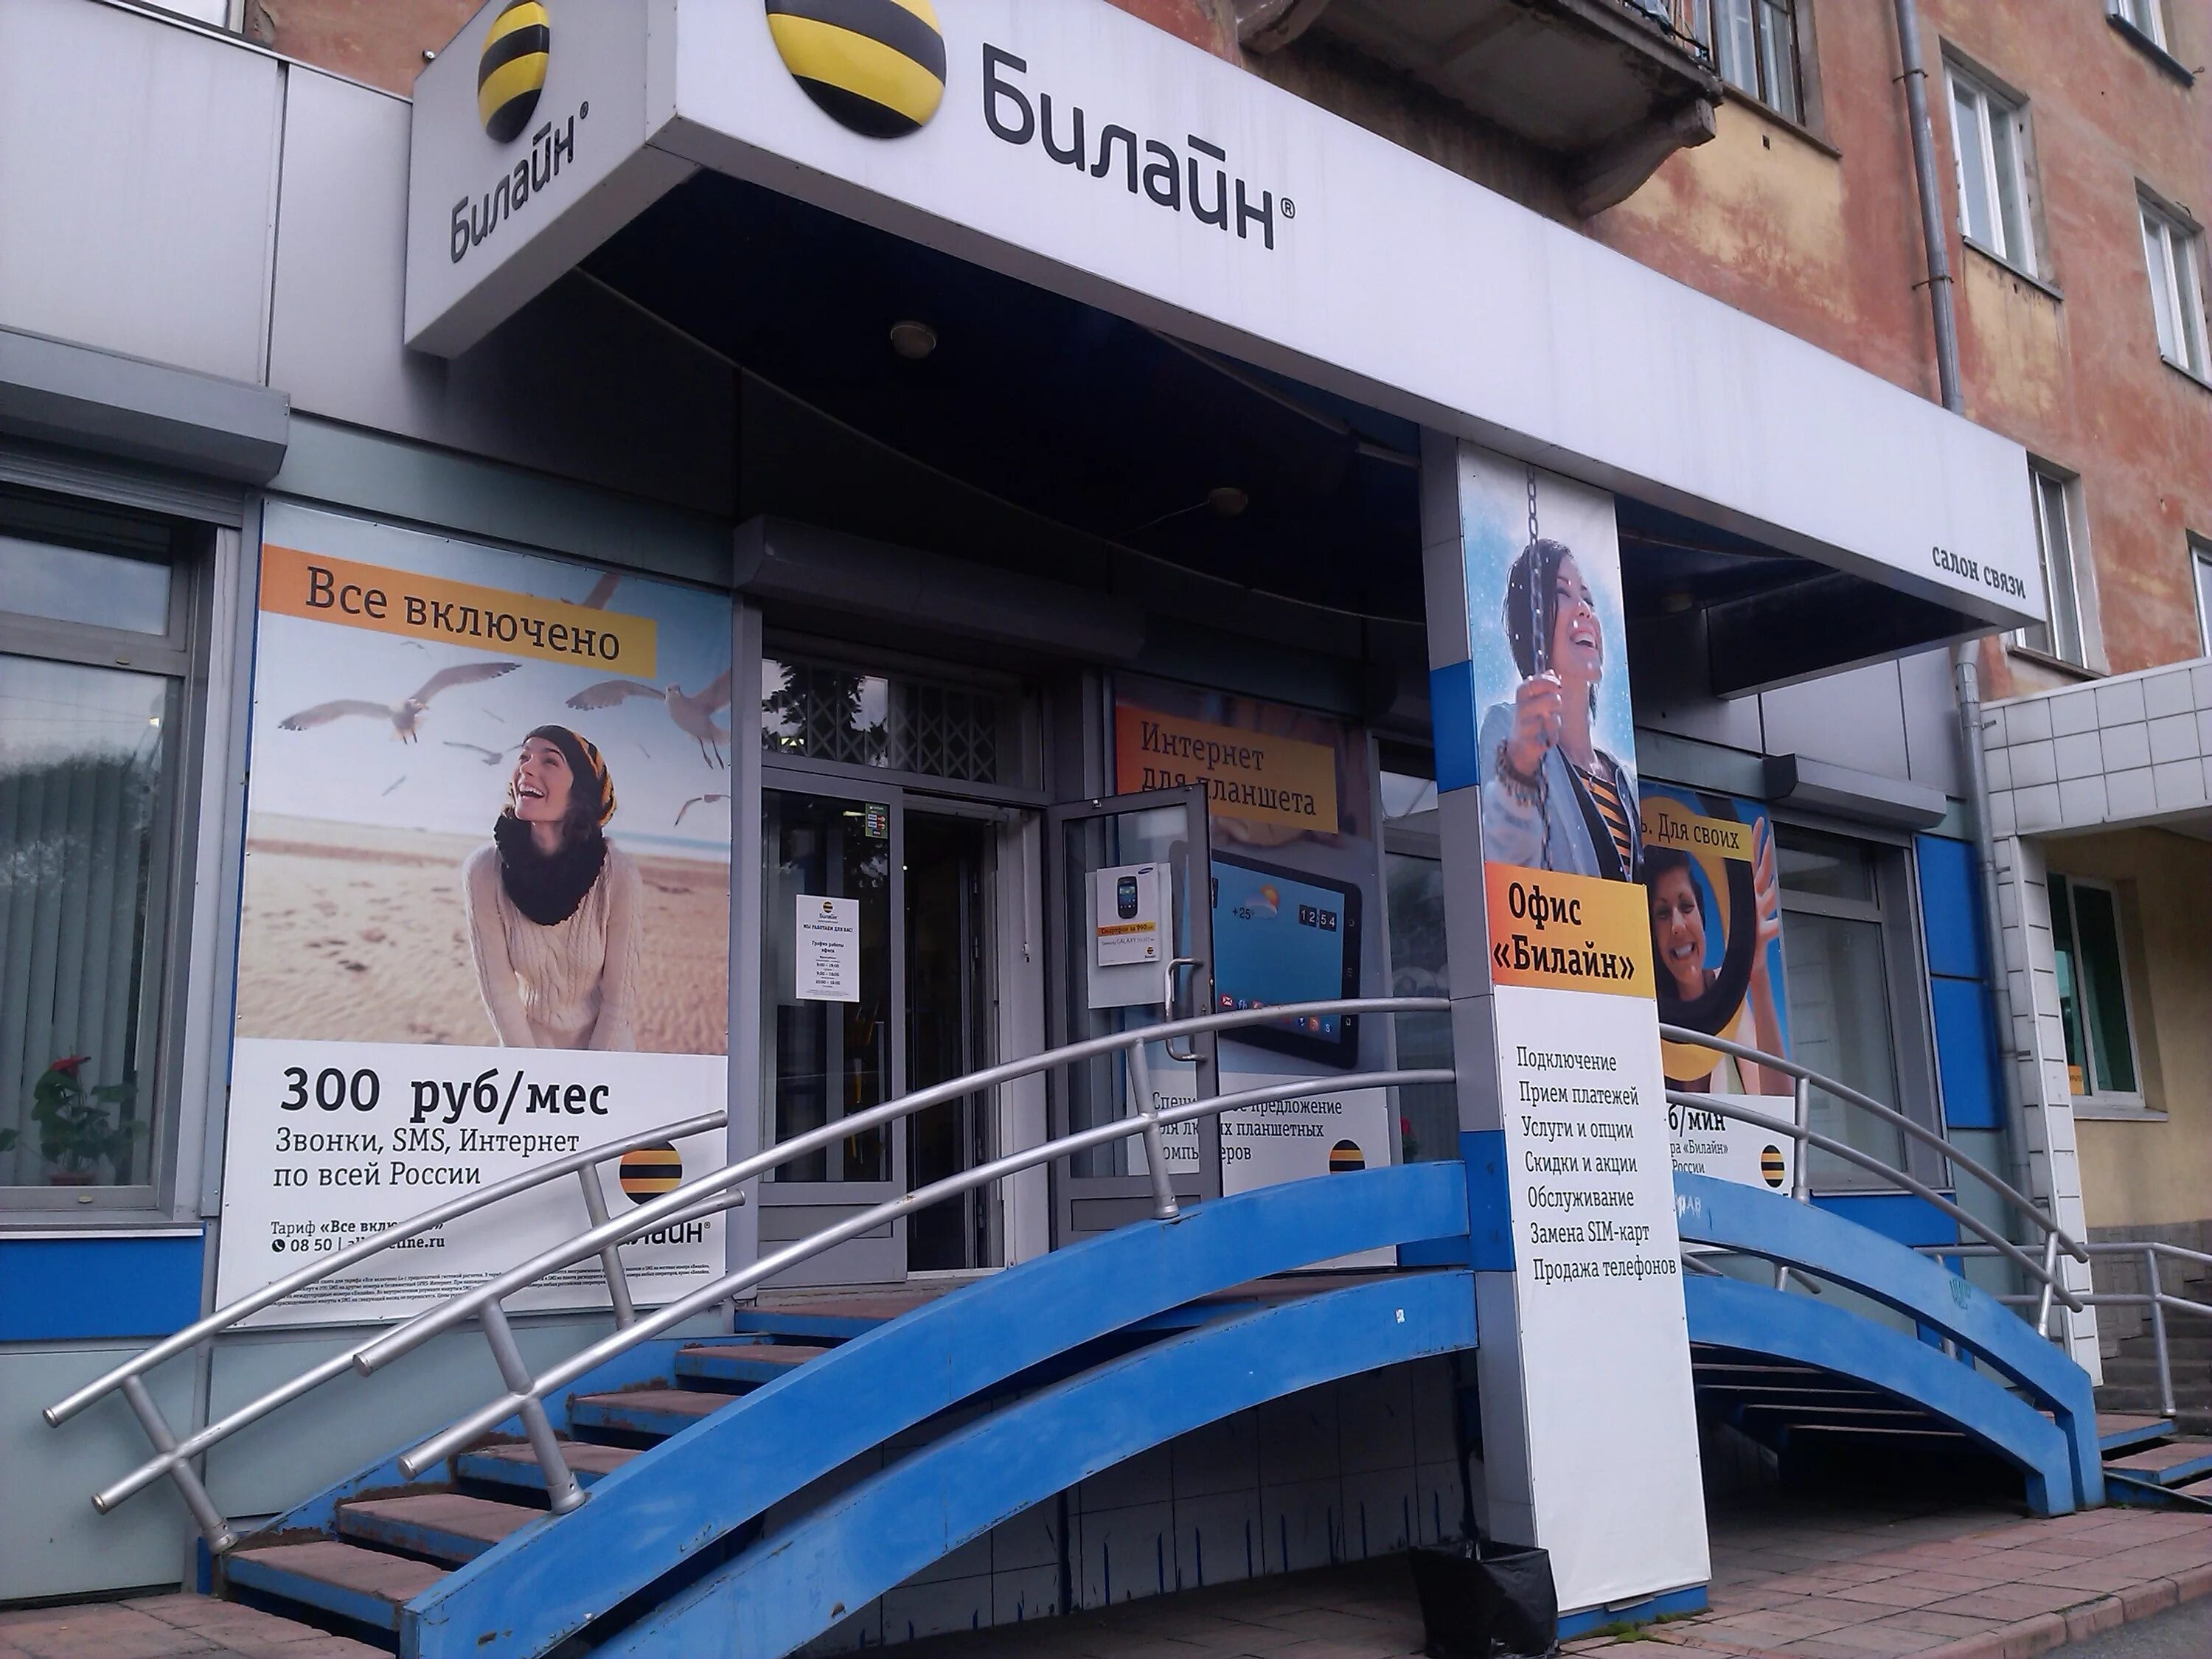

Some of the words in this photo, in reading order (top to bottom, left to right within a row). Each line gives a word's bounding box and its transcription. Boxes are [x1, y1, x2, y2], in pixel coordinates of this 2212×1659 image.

[1932, 546, 1980, 582] салон
[1983, 566, 2026, 599] связи
[305, 566, 388, 620] Все
[403, 595, 620, 661] включено
[1141, 721, 1264, 771] Интернет
[1659, 813, 1689, 844] Для
[1694, 825, 1740, 849] своих
[1509, 882, 1582, 931] Офис
[1493, 933, 1635, 980] «Билайн»
[1516, 1046, 1617, 1071] Подключение
[281, 1067, 380, 1112] 300
[410, 1068, 610, 1125] руб/мес
[1519, 1080, 1568, 1107] Прием
[1572, 1086, 1639, 1106] платежей
[276, 1127, 383, 1155] Звонки,
[392, 1128, 451, 1156] SMS,
[459, 1129, 580, 1158] Интернет
[1237, 1122, 1324, 1137] планшетных
[1521, 1115, 1573, 1143] Услуги
[1577, 1122, 1586, 1138] и
[1590, 1122, 1635, 1141] опции
[1683, 1139, 1728, 1154] «Билайн»
[273, 1167, 313, 1187] по
[318, 1163, 383, 1186] всей
[389, 1161, 481, 1186] России
[1525, 1151, 1579, 1176] Скидки
[1582, 1156, 1592, 1172] и
[1596, 1156, 1638, 1175] акции
[1528, 1186, 1635, 1213] Обслуживание
[271, 1220, 316, 1238] Тариф
[320, 1220, 355, 1233] «Все
[1530, 1222, 1585, 1245] Замена
[1588, 1220, 1649, 1246] SIM-карт
[291, 1239, 309, 1251] 08
[314, 1239, 331, 1251] 50
[1532, 1258, 1600, 1285] Продажа
[1602, 1254, 1677, 1281] телефонов
